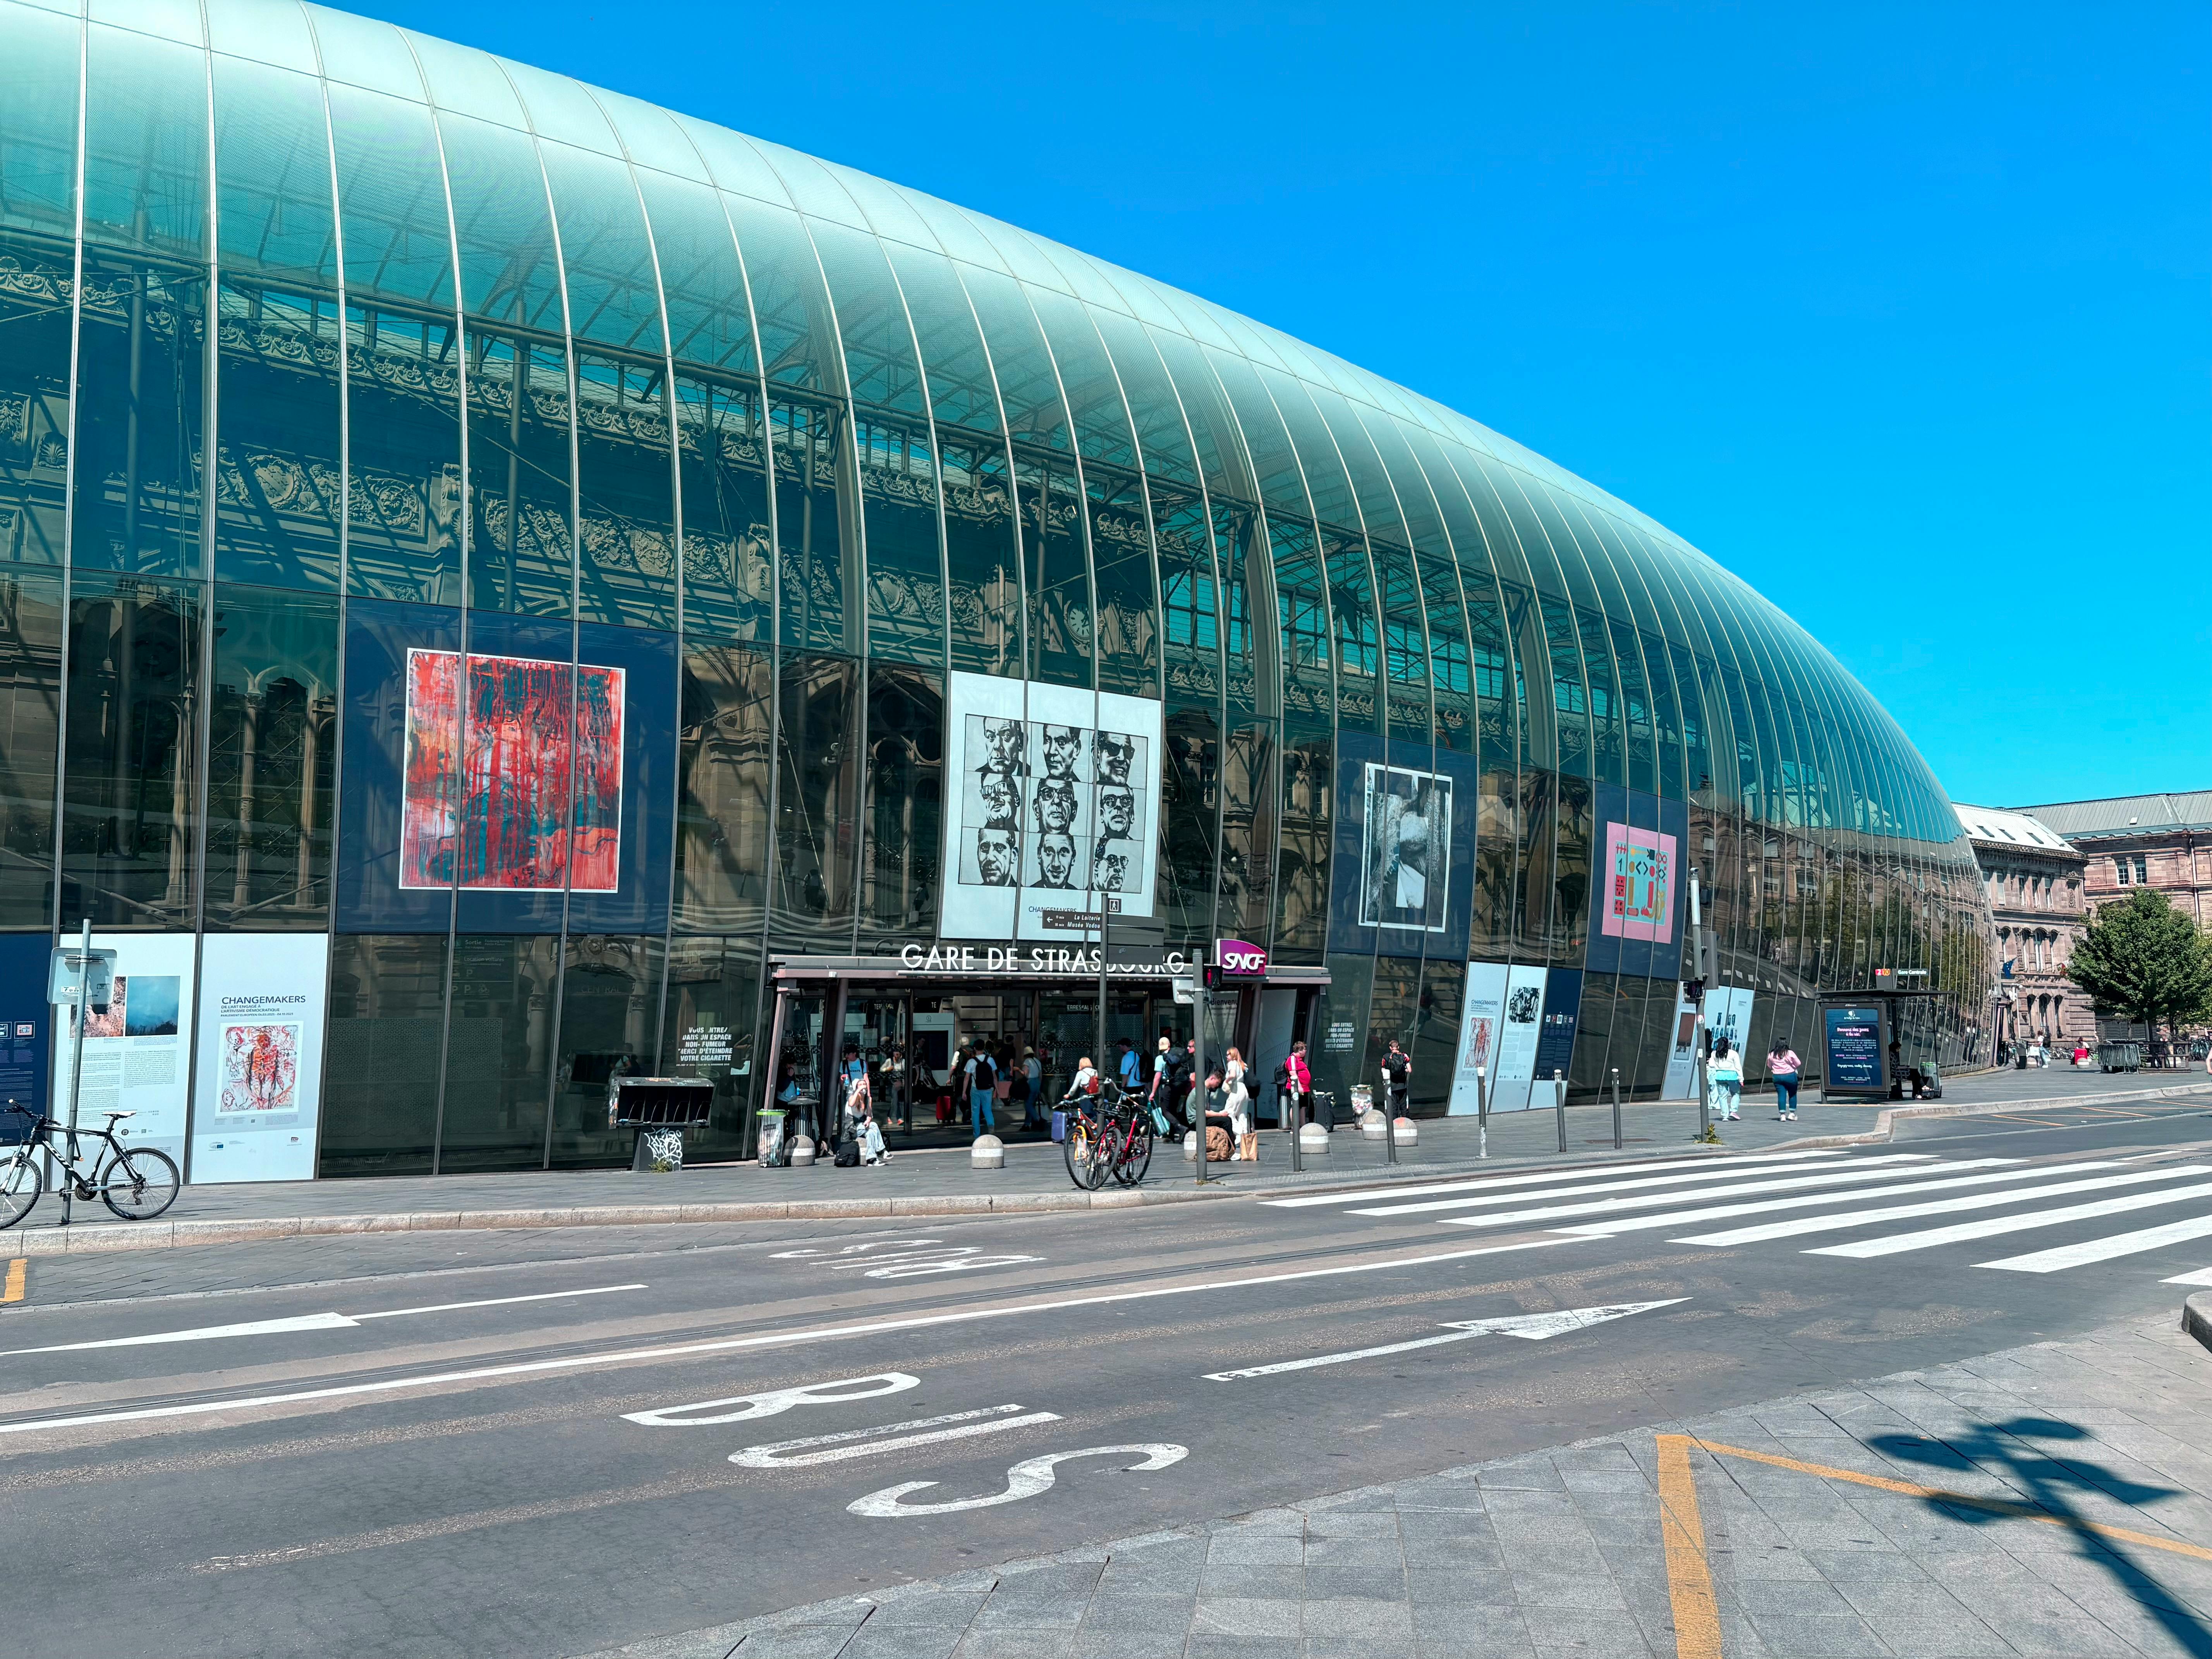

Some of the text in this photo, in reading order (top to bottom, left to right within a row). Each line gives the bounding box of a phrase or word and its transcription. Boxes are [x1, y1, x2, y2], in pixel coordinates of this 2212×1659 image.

[902, 944, 974, 970] GARE
[988, 947, 1018, 970] DE
[1031, 948, 1185, 973] STRASG
[1222, 952, 1266, 970] SNCF
[222, 995, 306, 1004] CHANGEMAKERS
[768, 1239, 1048, 1279] BUS
[619, 1372, 1190, 1517] BUS
